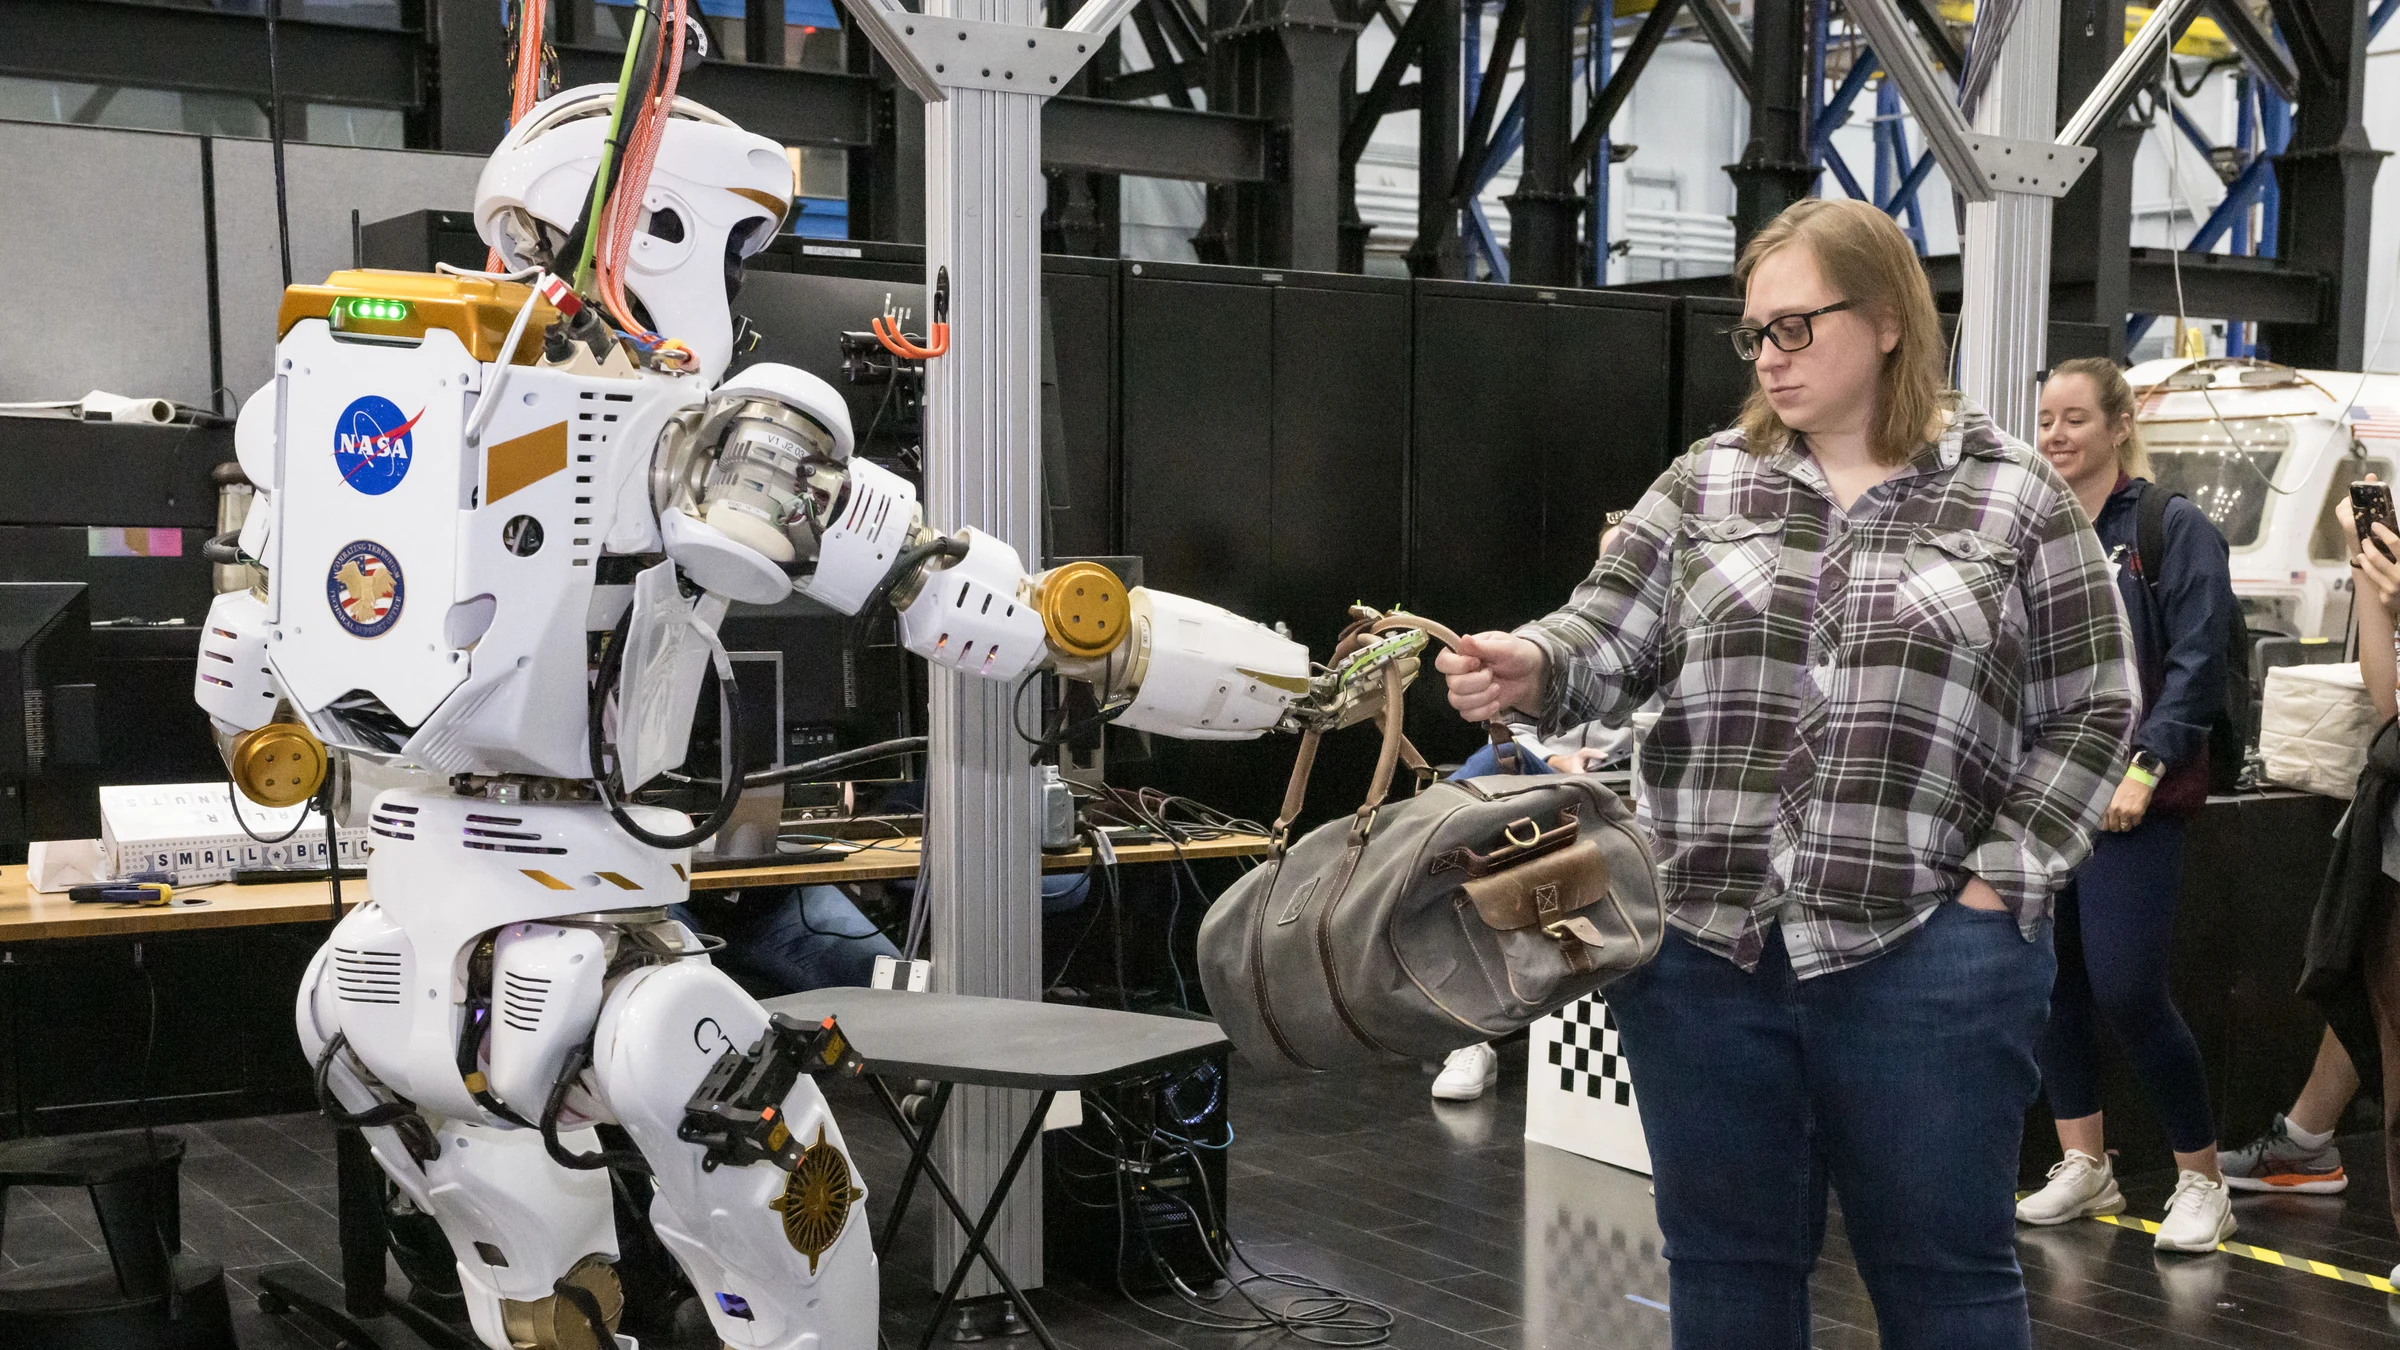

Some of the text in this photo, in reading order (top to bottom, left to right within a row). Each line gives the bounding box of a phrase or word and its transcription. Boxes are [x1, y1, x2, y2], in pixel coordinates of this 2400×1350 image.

[340, 433, 408, 459] NASA
[767, 434, 780, 446] V1
[782, 440, 793, 451] J2
[333, 543, 400, 579] COMBATING TERRORISM
[330, 590, 354, 630] TECHNICAL
[158, 840, 368, 867] SMALL BATC
